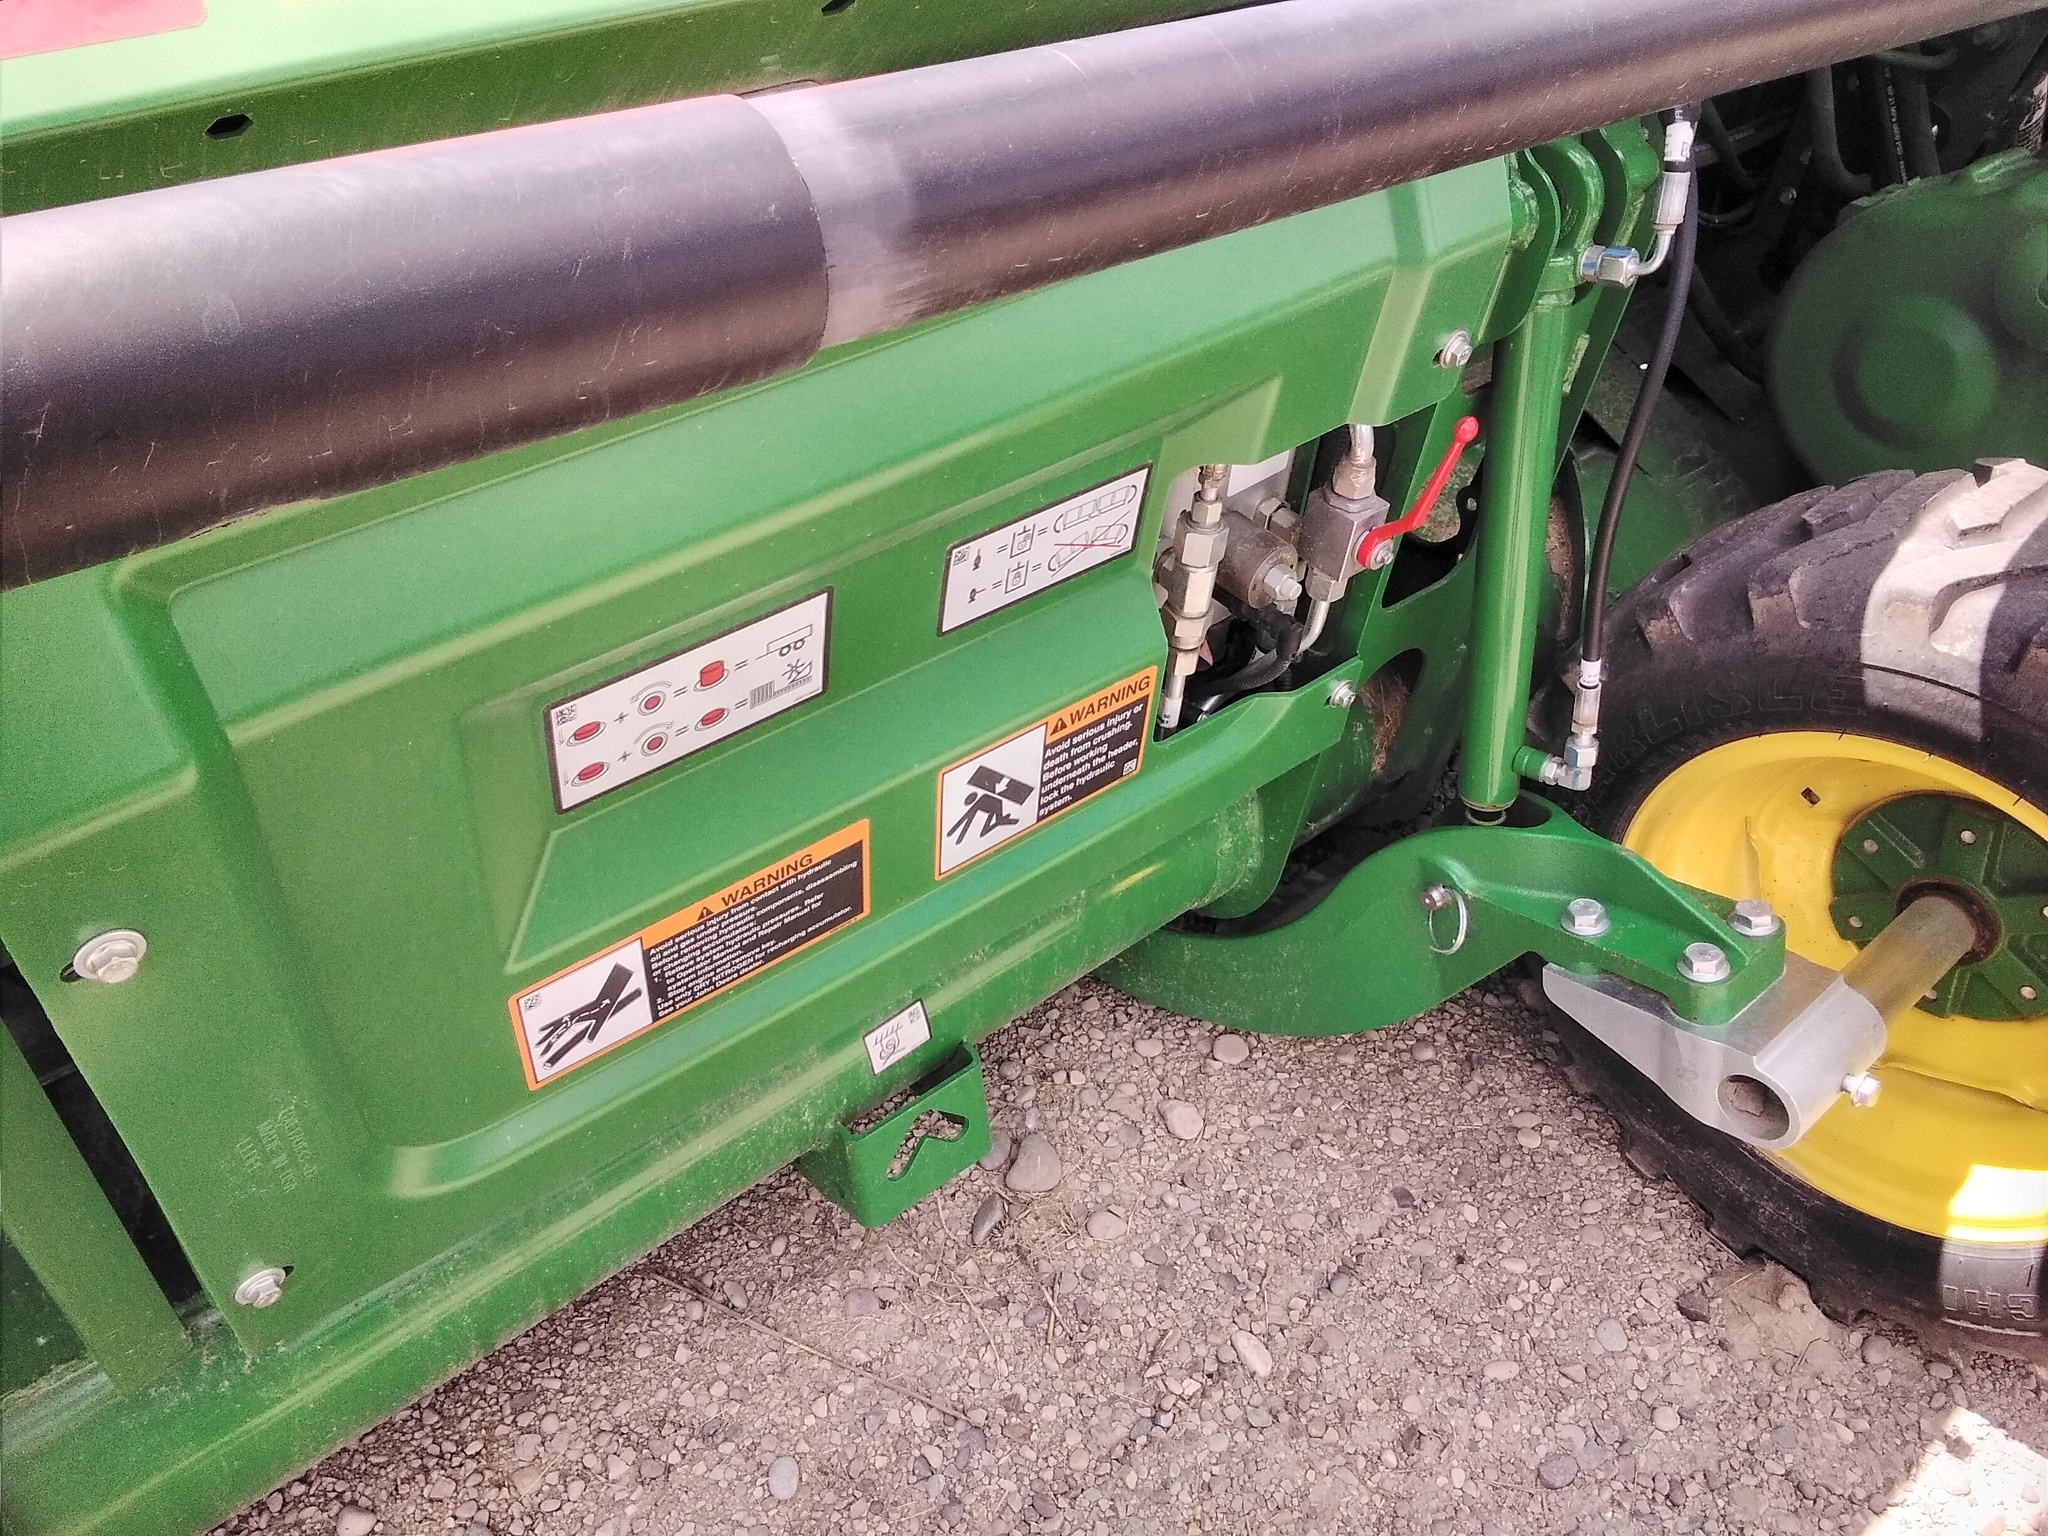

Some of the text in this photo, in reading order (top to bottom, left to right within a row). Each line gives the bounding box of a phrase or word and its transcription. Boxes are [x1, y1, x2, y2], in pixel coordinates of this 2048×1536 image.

[1069, 675, 1150, 725] WARNING
[1043, 720, 1132, 770] death from crushing.
[1044, 703, 1143, 758] Avoid serious injury or
[1040, 789, 1058, 805] lock
[1060, 782, 1074, 794] the
[1075, 760, 1115, 786] hydraulic
[1041, 738, 1138, 793] underneath the header,
[1042, 743, 1107, 782] Before working
[1038, 794, 1072, 815] system.
[649, 859, 831, 955] Avoid serious injury from contact with hydraulic
[720, 853, 812, 906] WARNING
[650, 906, 757, 962] oil and gas under pressure.
[651, 860, 857, 969] Before removing hydraulic components, disassembling
[664, 959, 694, 977] Relieve
[695, 944, 724, 961] system
[725, 925, 760, 946] hydraulic
[804, 892, 824, 905] Refer
[676, 957, 711, 978] Operator
[712, 942, 740, 960] Manual
[742, 933, 756, 945] and
[757, 921, 782, 937] Repair
[783, 905, 810, 923] Manual
[811, 900, 821, 909] for
[652, 968, 661, 976] or
[663, 949, 700, 971] changing
[657, 999, 673, 1010] Use
[674, 989, 691, 1001] only
[693, 979, 710, 991] DRY
[712, 956, 753, 982] NITROGEN
[754, 951, 765, 959] for
[766, 930, 806, 953] recharging
[807, 906, 851, 932] accumulator.
[667, 985, 686, 997] Stop
[687, 971, 714, 987] engine
[715, 961, 730, 973] and
[731, 947, 760, 964] remove
[761, 939, 775, 949] key.
[667, 949, 743, 991] system information.
[658, 959, 763, 1016] See your John Deere dealer.
